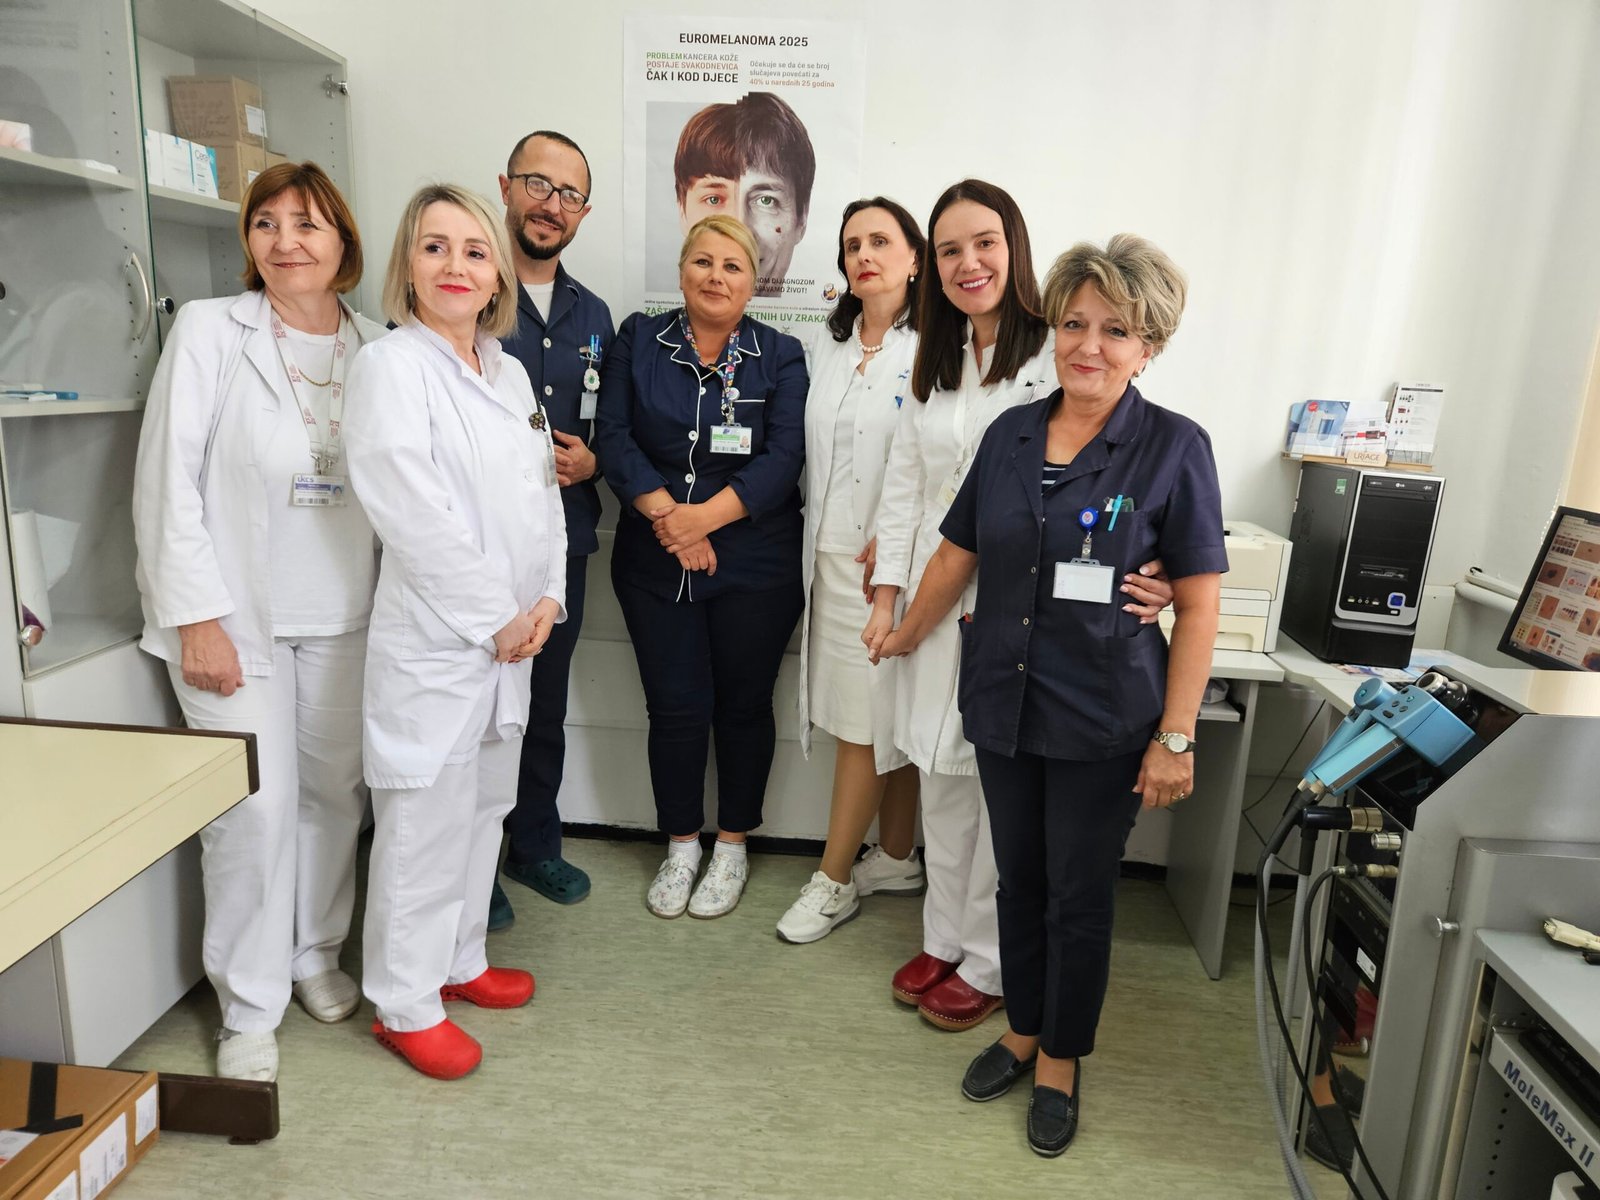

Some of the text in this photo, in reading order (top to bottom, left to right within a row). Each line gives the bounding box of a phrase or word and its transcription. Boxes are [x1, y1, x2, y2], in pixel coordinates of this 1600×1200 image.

[679, 33, 809, 47] EUROMELANOMA 2025
[646, 52, 739, 61] PROBLEM KANCERA KOŽE
[646, 61, 739, 70] POSTAJE SVAKODNEVICA
[749, 60, 777, 69] Očekuje
[816, 62, 830, 70] broj
[646, 67, 668, 81] ČAK
[677, 71, 700, 82] KOD
[703, 72, 739, 83] DJECE
[749, 69, 781, 78] slučajeva
[749, 78, 764, 86] 40%
[771, 79, 800, 87] narednih
[812, 80, 835, 88] godina
[771, 277, 815, 286] DIJAGNOZOM
[786, 285, 807, 294] ŽIVOT!
[645, 304, 827, 323] ZAŠT ETNIH UV ZRAKA
[1503, 1060, 1577, 1150] MoleMax
